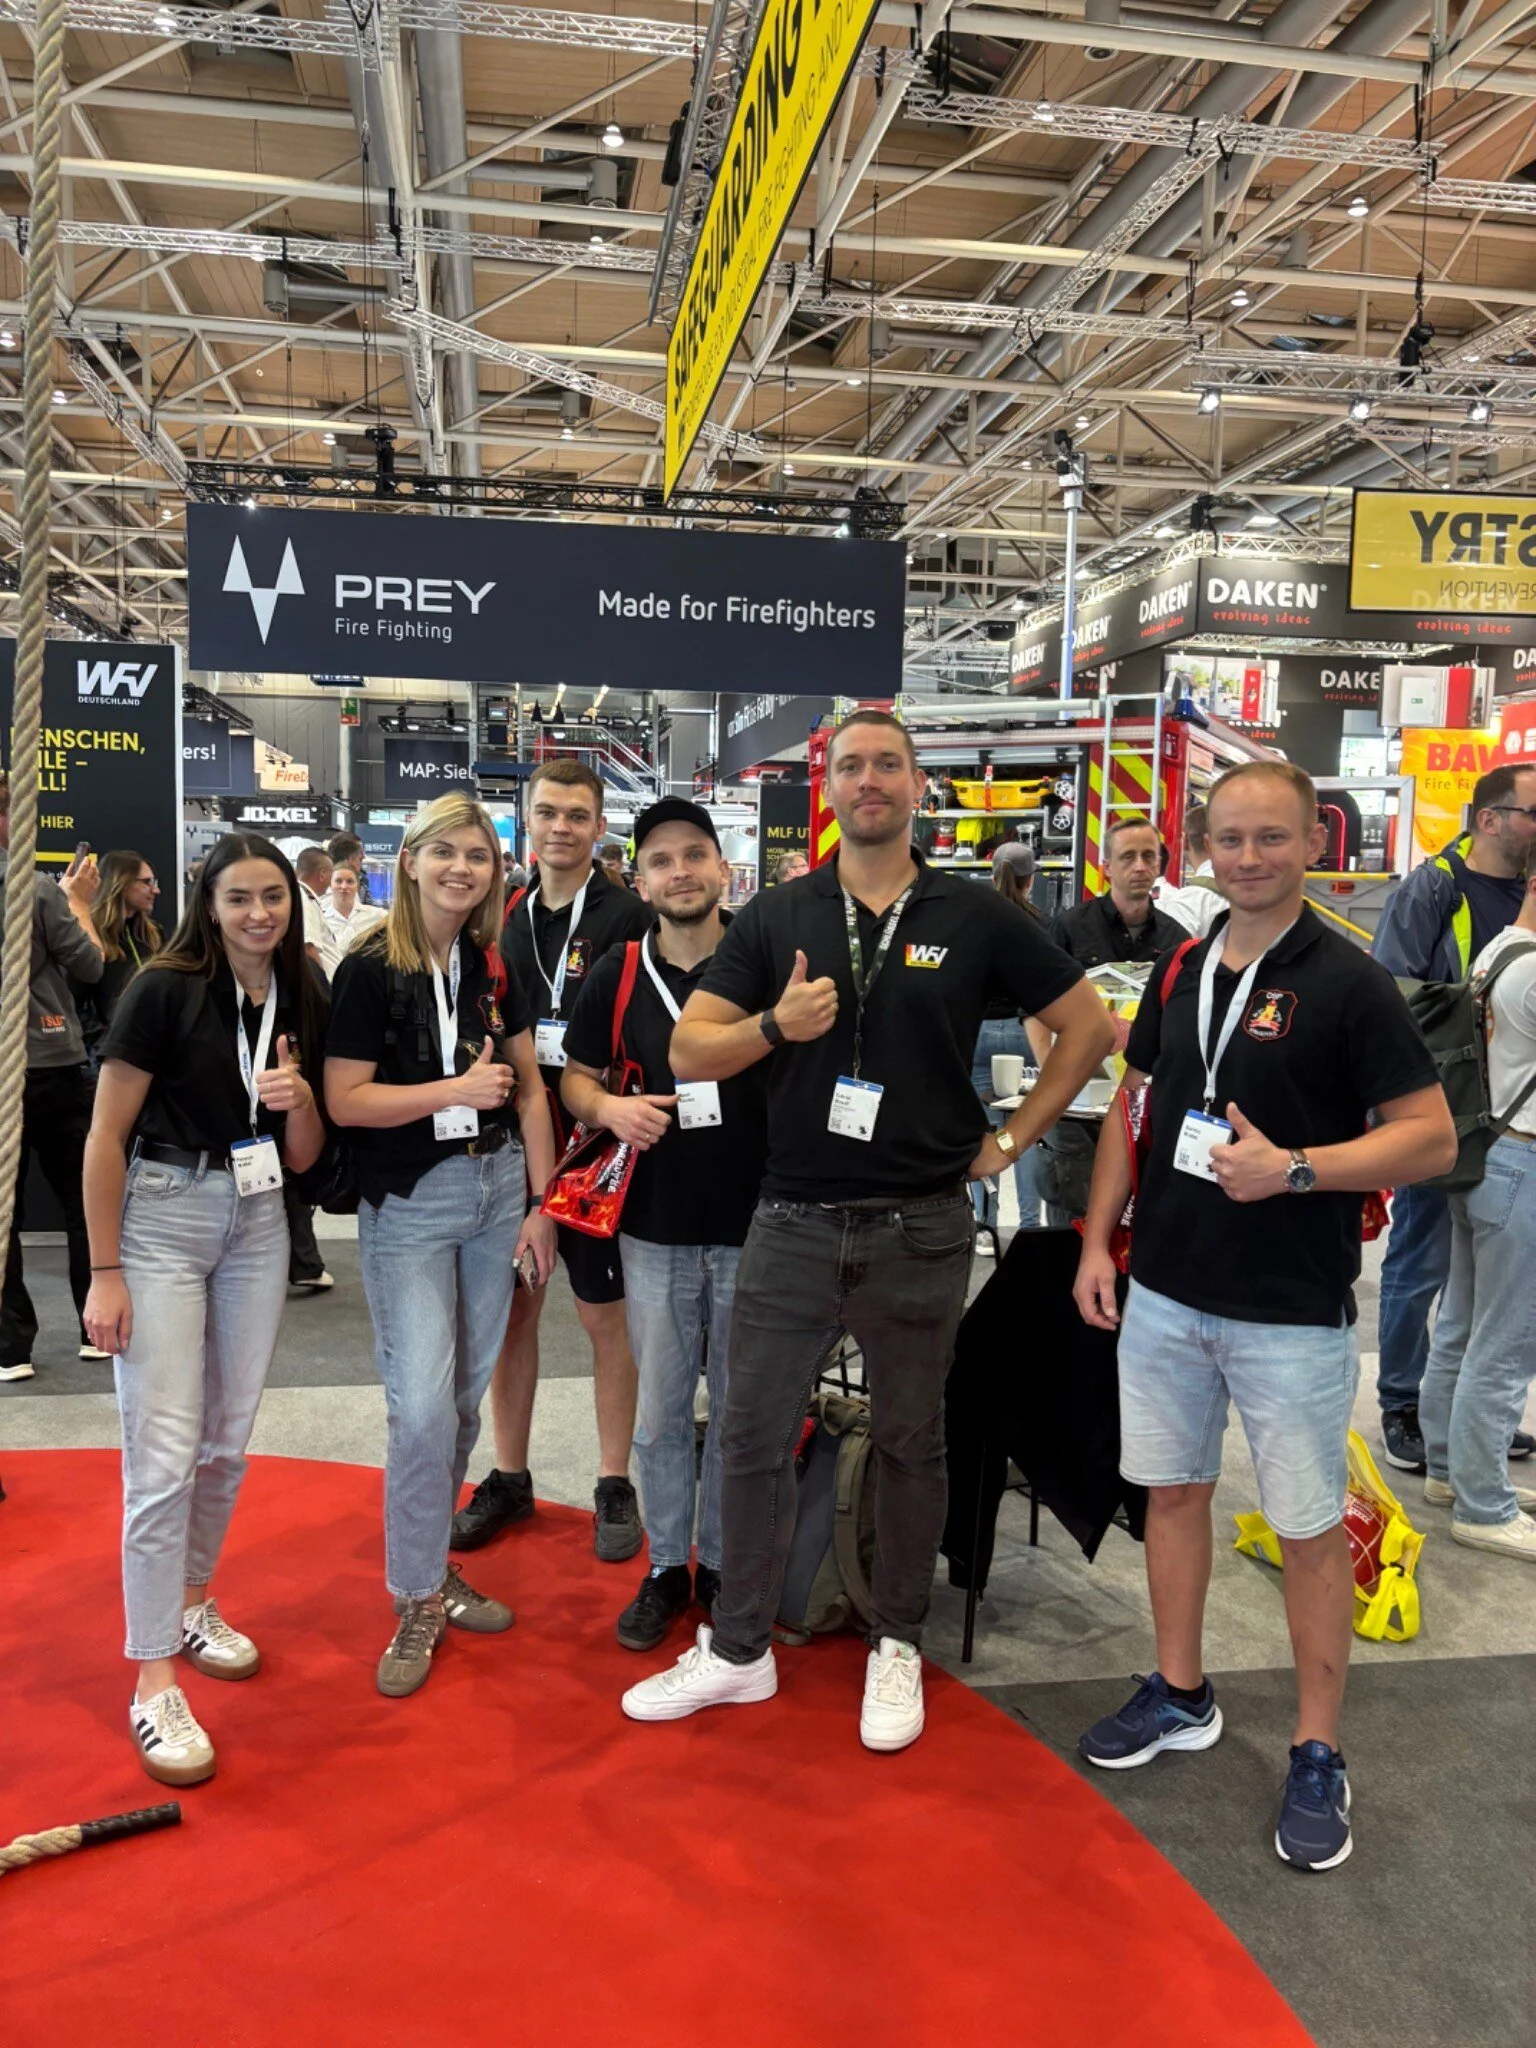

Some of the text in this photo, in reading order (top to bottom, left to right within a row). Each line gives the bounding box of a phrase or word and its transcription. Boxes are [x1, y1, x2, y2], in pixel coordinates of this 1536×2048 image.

[817, 2, 842, 98] AND
[335, 574, 496, 614] PREY
[1207, 577, 1319, 609] DAKEN
[599, 590, 876, 632] Made for Firefighters
[1138, 584, 1189, 624] DAKEN
[1213, 611, 1310, 626] evolving ideas
[1416, 619, 1512, 635] evolving ideas
[335, 617, 453, 643] Fire Fighting
[78, 696, 141, 707] DEUTSCHLAND
[399, 761, 440, 779] MAP:
[1425, 778, 1451, 790] Fire
[40, 815, 74, 829] HIER
[767, 826, 794, 839] MLF
